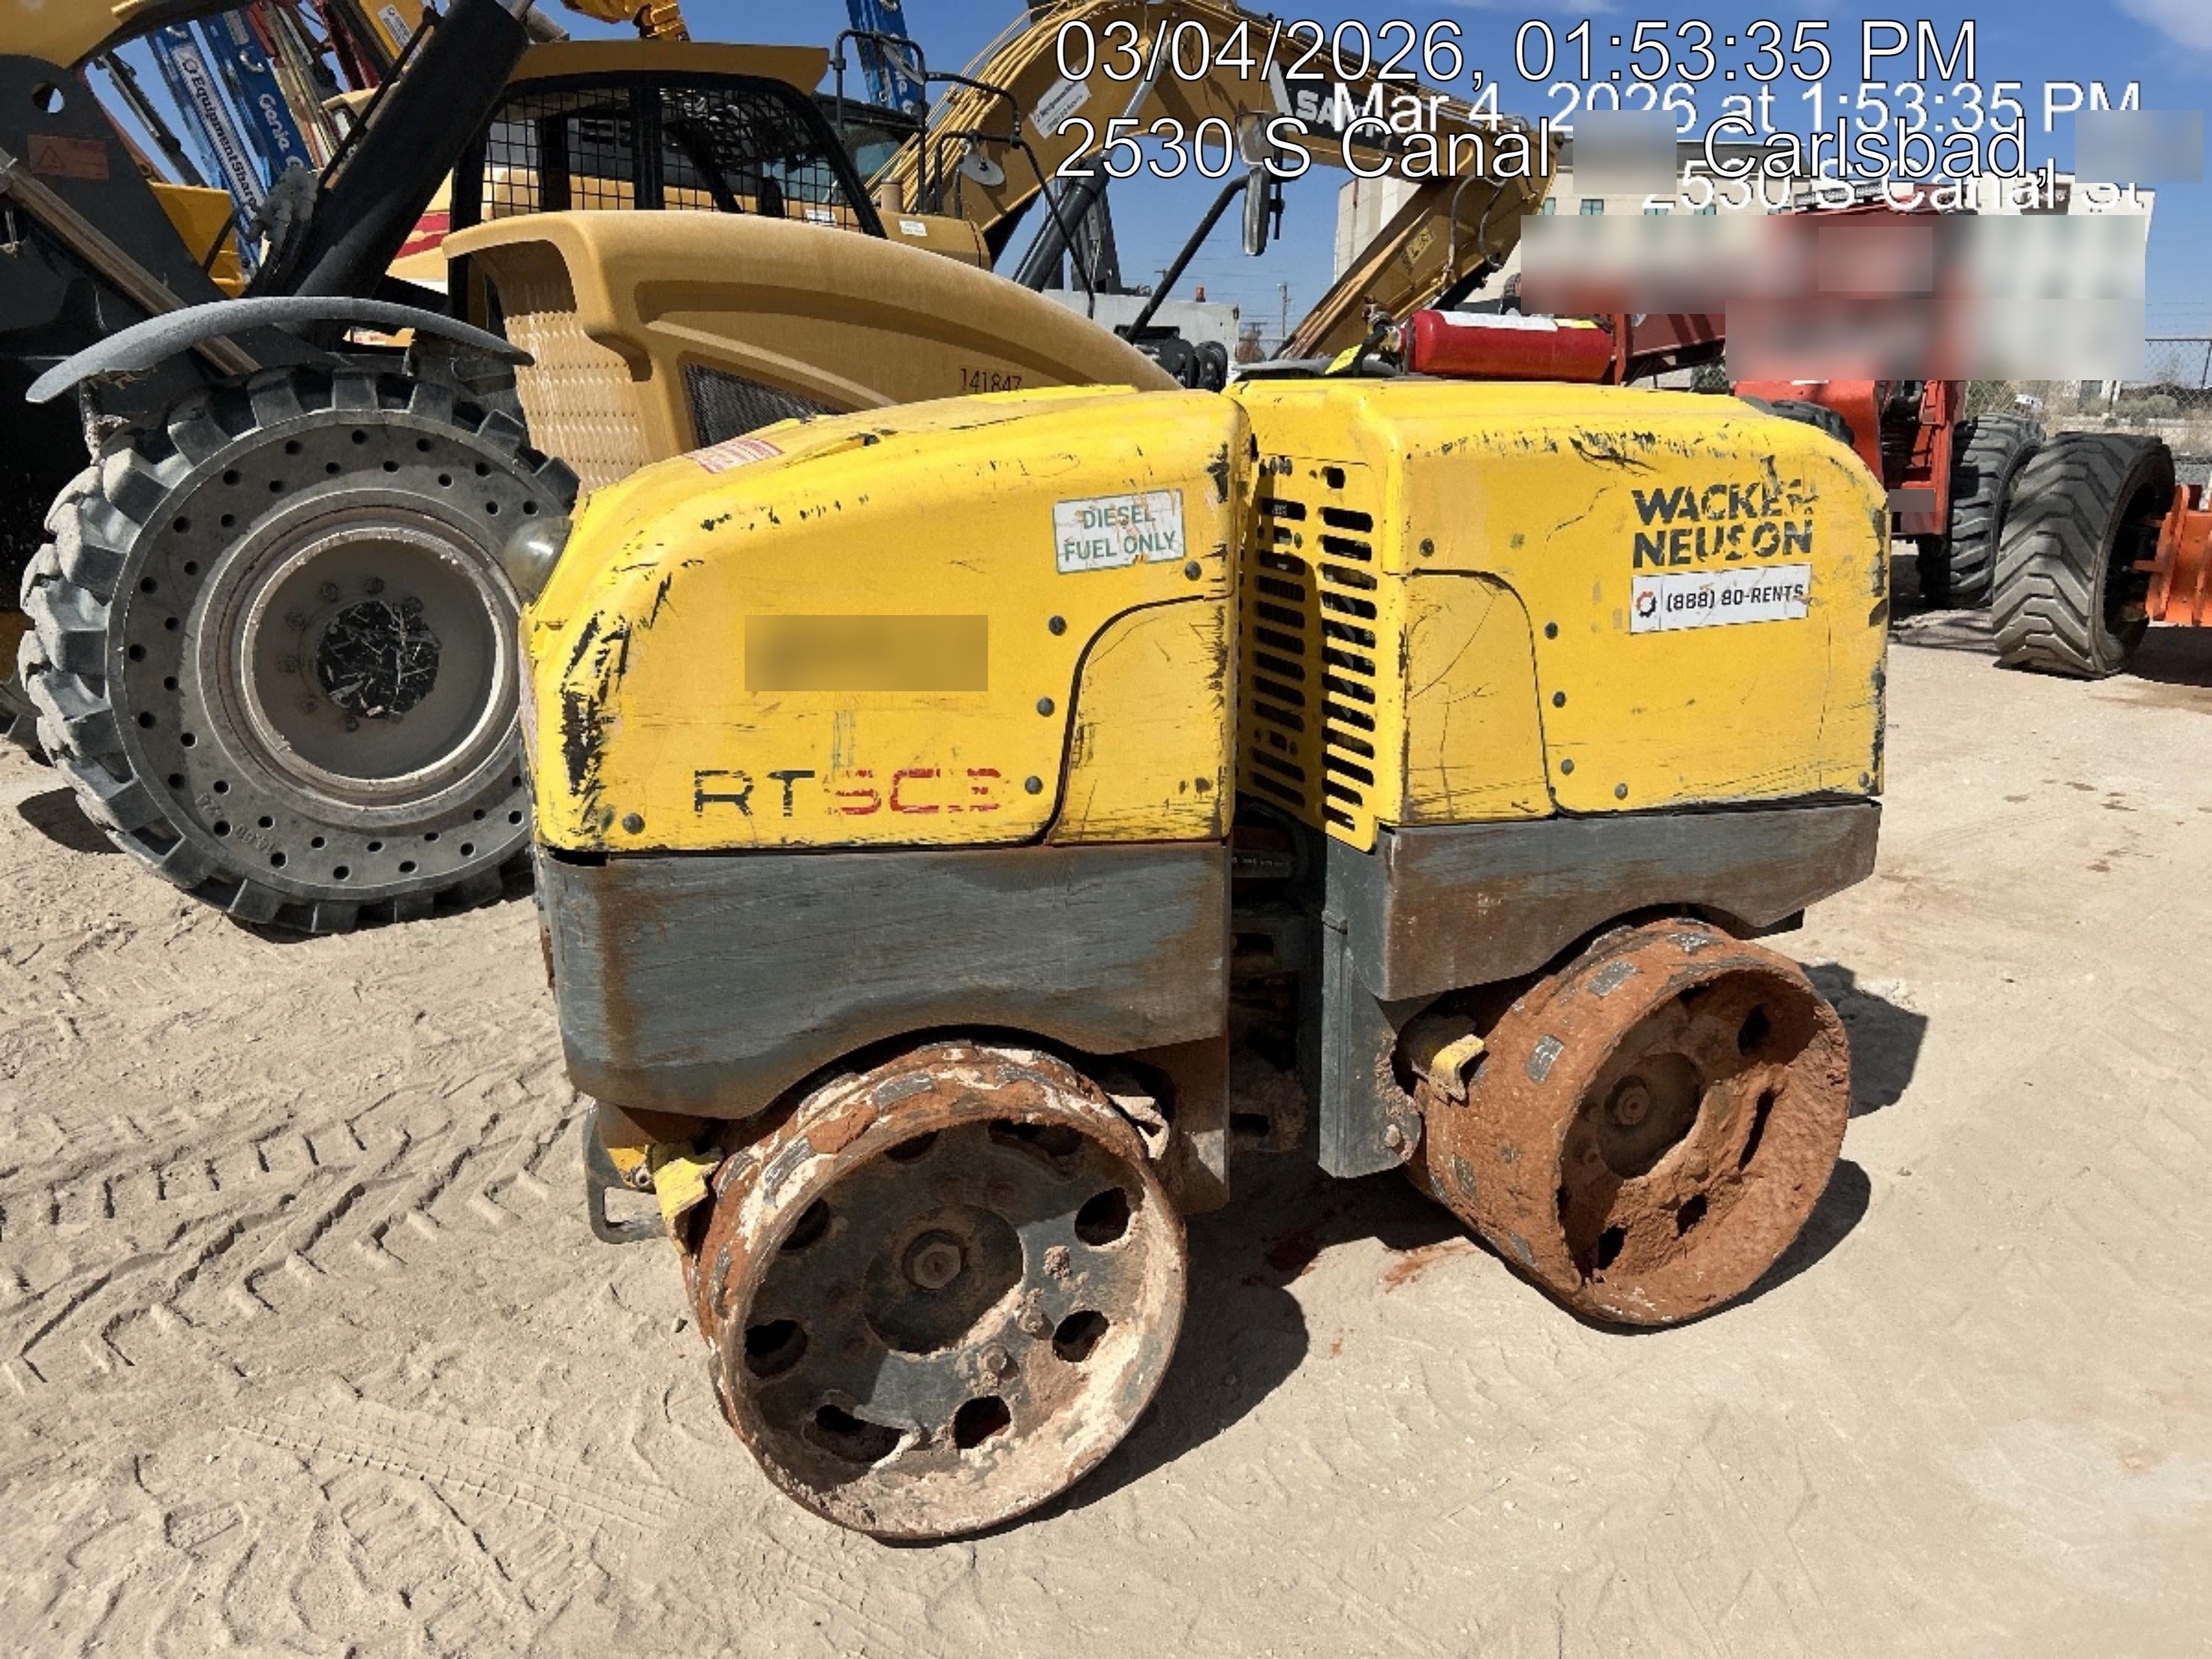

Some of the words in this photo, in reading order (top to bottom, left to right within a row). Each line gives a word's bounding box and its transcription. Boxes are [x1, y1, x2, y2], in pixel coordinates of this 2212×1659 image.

[259, 93, 290, 152] Genie
[960, 368, 1022, 394] 141847
[1083, 505, 1156, 530] DIESEL
[1062, 538, 1118, 562] FUEL
[1124, 531, 1176, 554] ONLY
[1633, 520, 1813, 568] NEUSON
[1666, 590, 1716, 612] (888)
